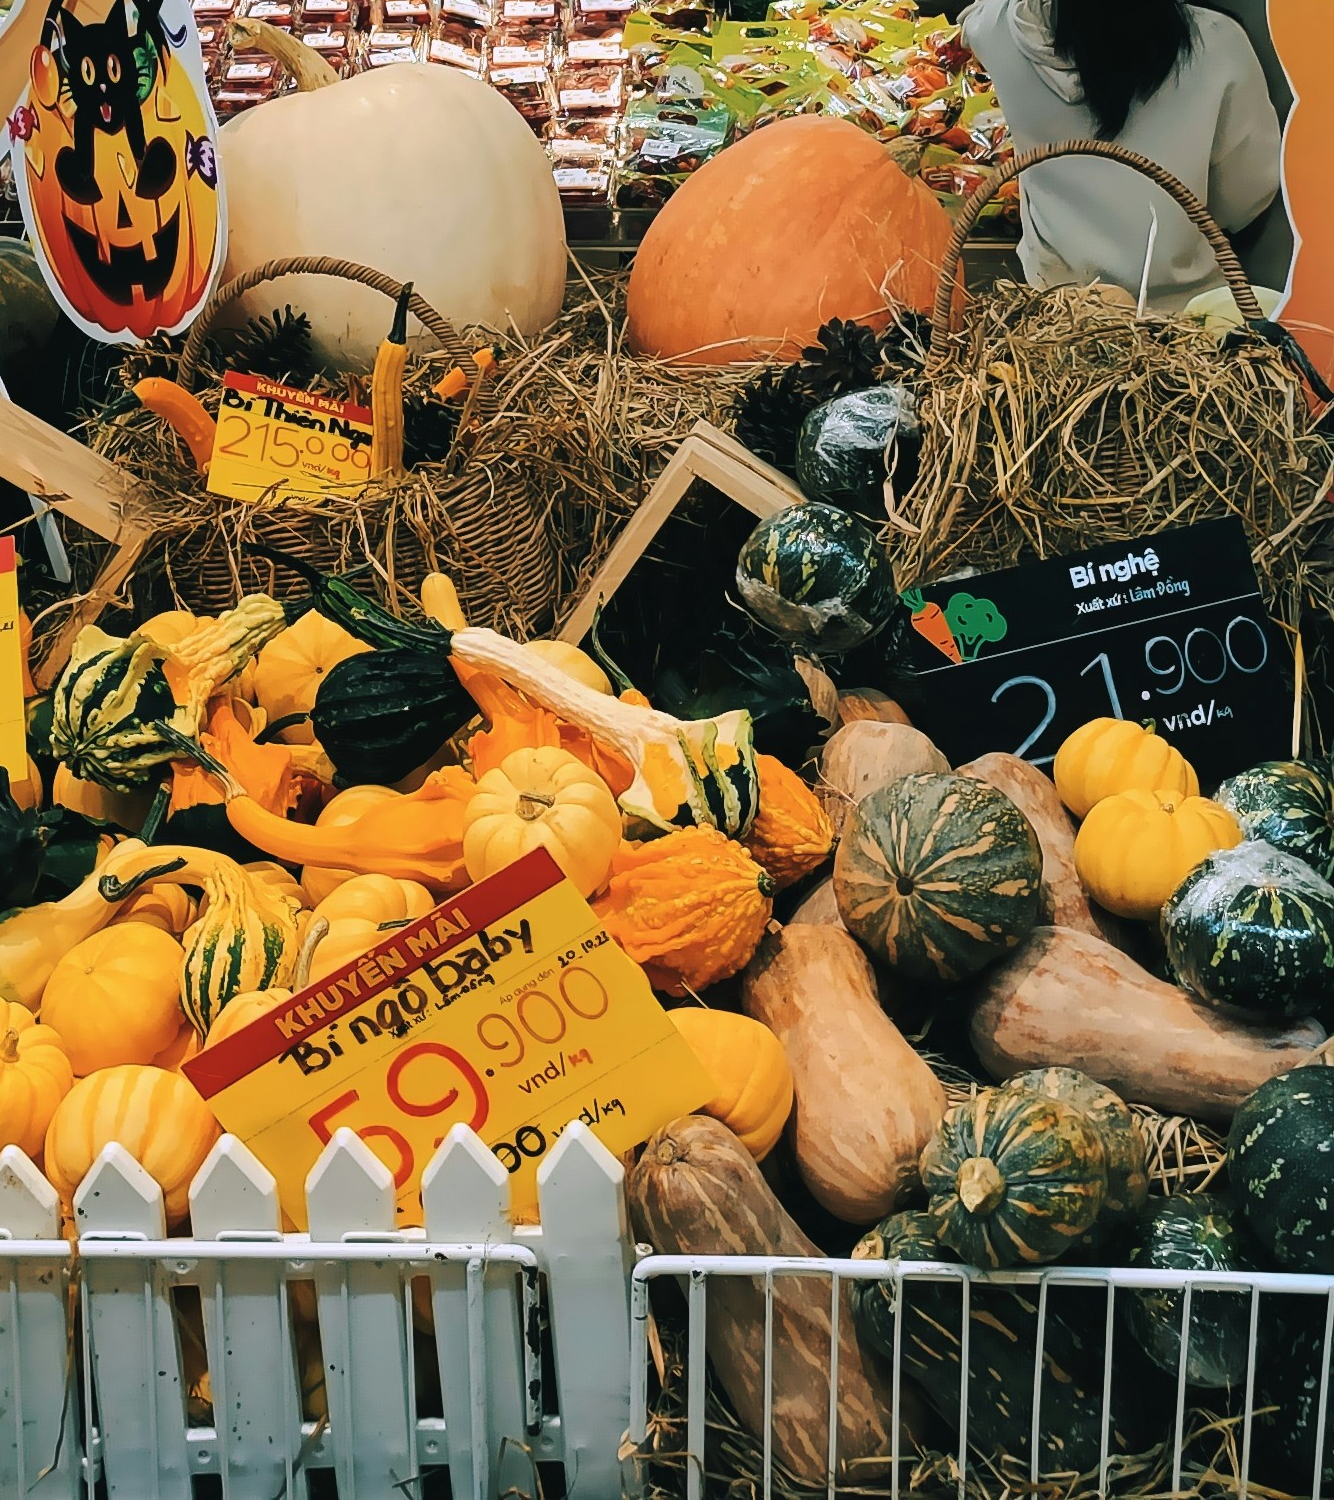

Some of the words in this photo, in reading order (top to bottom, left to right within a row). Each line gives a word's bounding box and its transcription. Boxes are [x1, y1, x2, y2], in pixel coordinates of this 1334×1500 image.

[1069, 560, 1097, 590] Bí
[1098, 546, 1161, 584] nghệ
[990, 614, 1268, 767] 21.900
[273, 940, 409, 1041] KHUYẾN
[410, 905, 472, 960] MÃI
[348, 976, 430, 1042] ngô
[421, 916, 535, 997] baby
